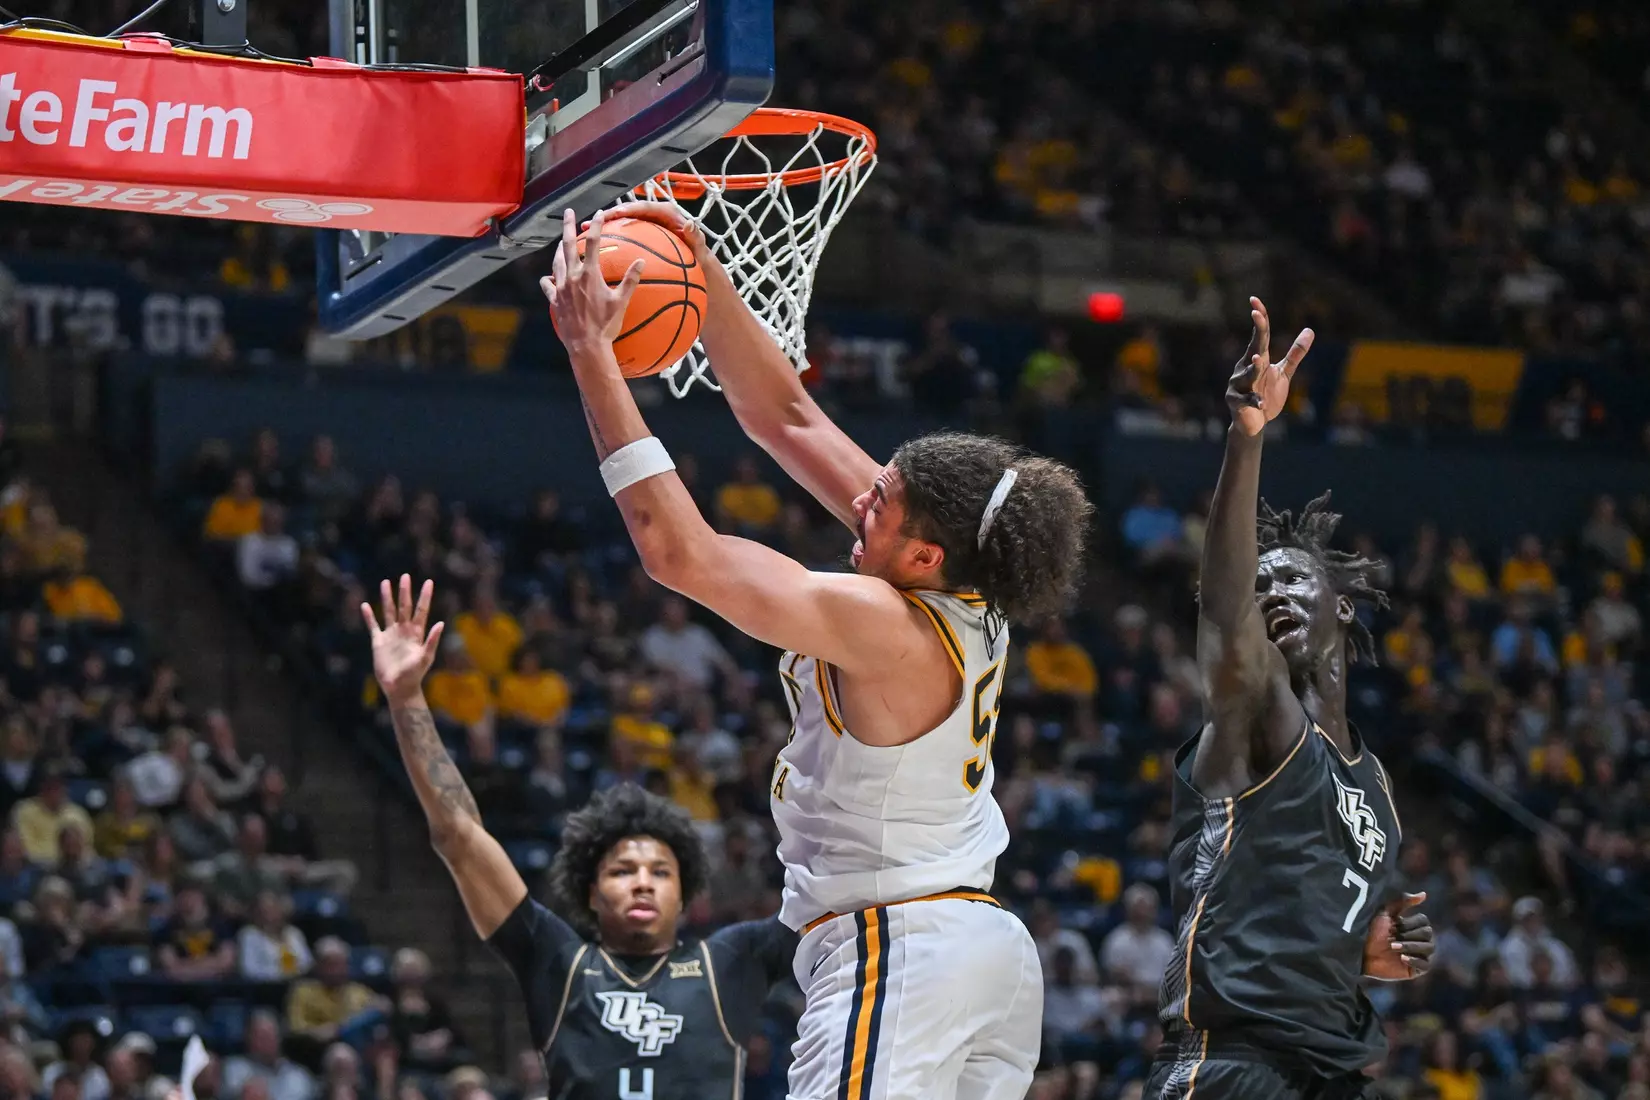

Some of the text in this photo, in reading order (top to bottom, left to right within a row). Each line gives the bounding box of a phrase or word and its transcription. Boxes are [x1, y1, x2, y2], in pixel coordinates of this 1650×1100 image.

[1332, 773, 1387, 872] UCF
[1342, 868, 1369, 933] 7
[595, 991, 683, 1056] UCF
